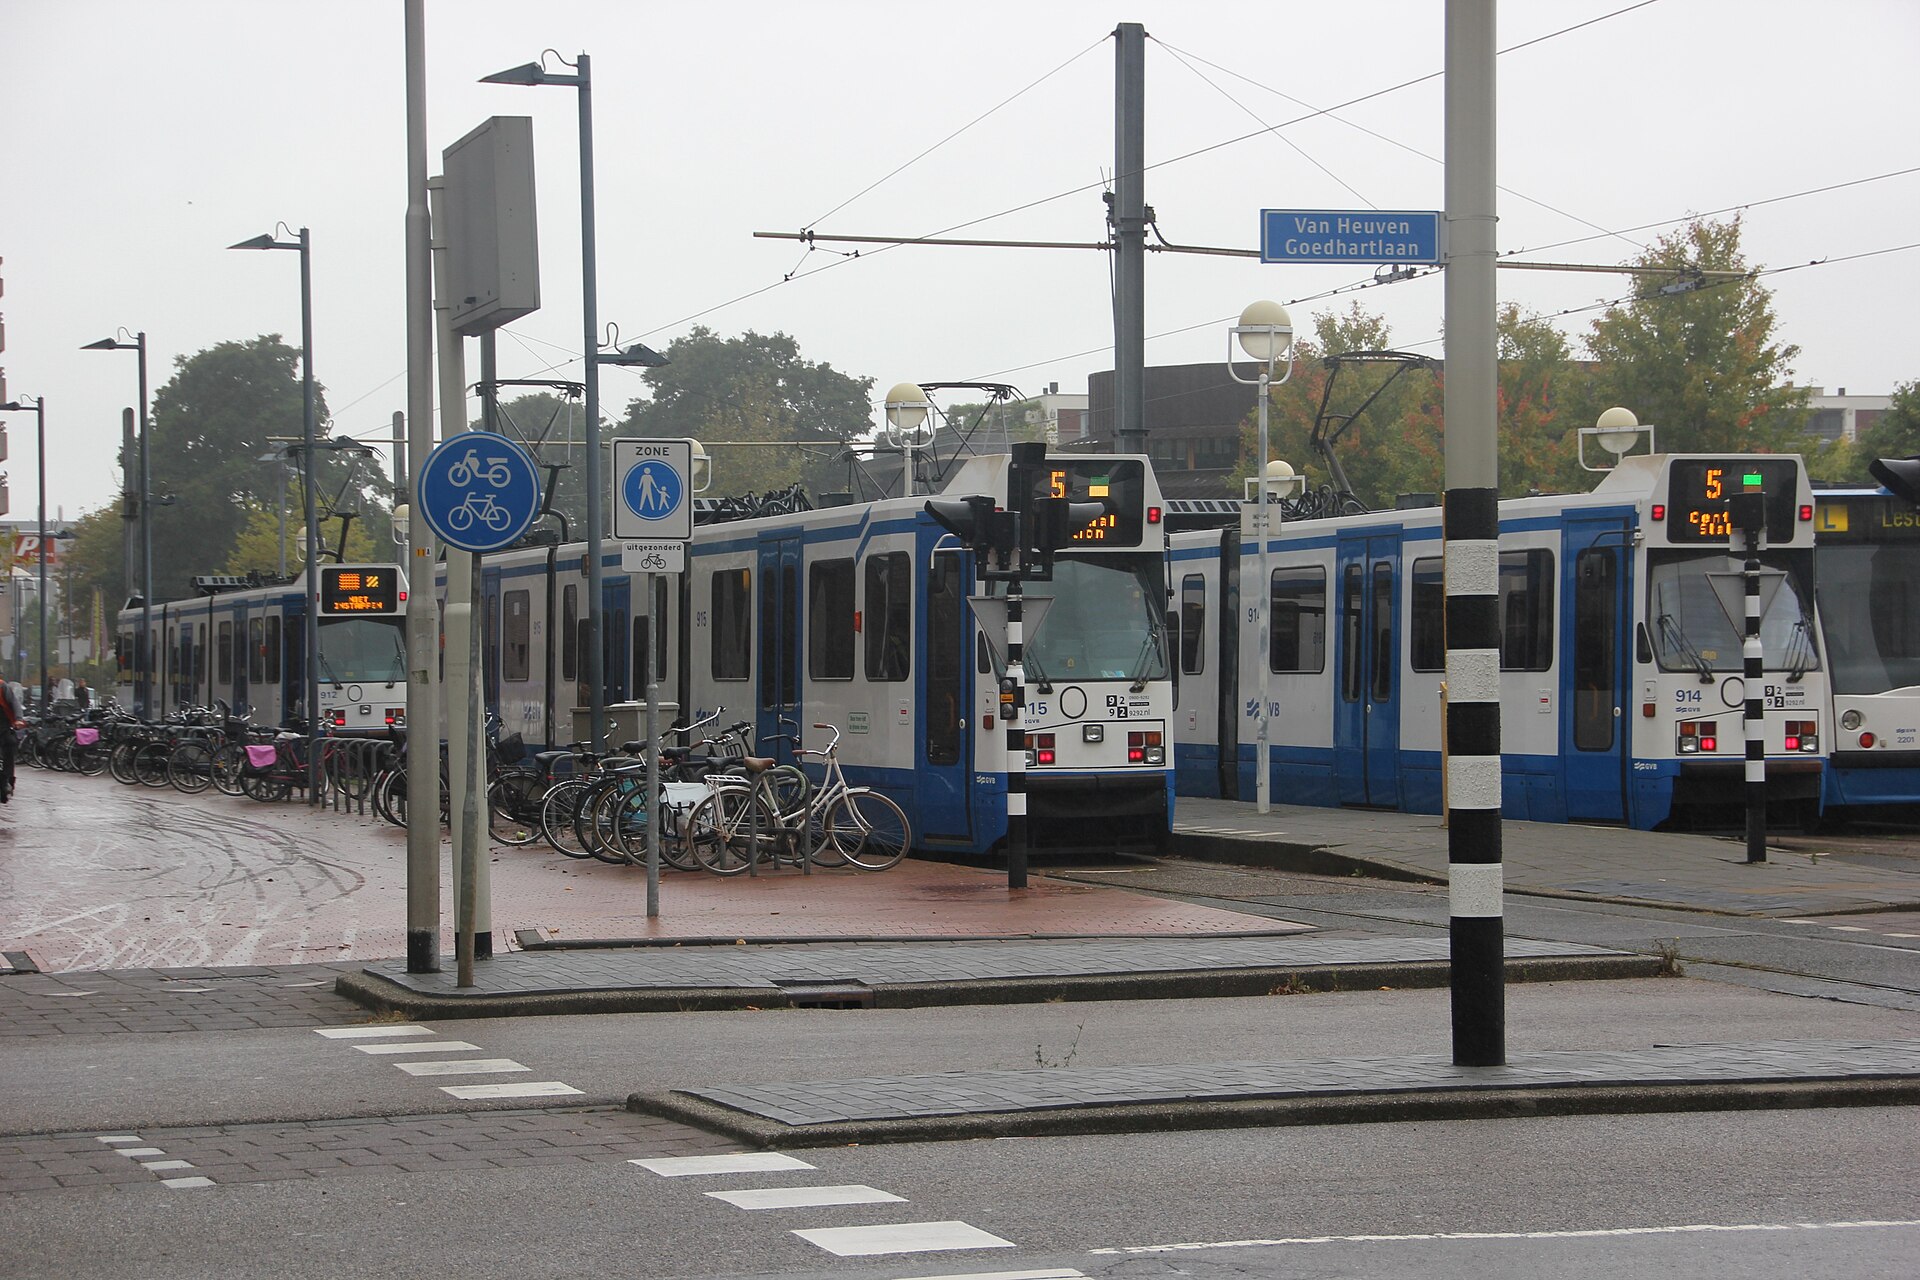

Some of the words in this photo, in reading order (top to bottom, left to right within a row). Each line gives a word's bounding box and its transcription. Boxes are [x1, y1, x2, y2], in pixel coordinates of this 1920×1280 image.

[1294, 217, 1330, 234] Van
[1337, 217, 1410, 235] Heuven
[1285, 238, 1419, 256] Goedhartlaan
[635, 446, 670, 456] ZONE
[1050, 471, 1066, 499] 5
[1706, 469, 1722, 499] 5
[1823, 507, 1837, 529] L
[626, 544, 682, 552] uitgezonderd
[1247, 607, 1260, 623] 91
[320, 691, 338, 699] 912
[1675, 689, 1702, 703] 914
[1024, 701, 1048, 715] 15
[1897, 736, 1915, 744] 2201
